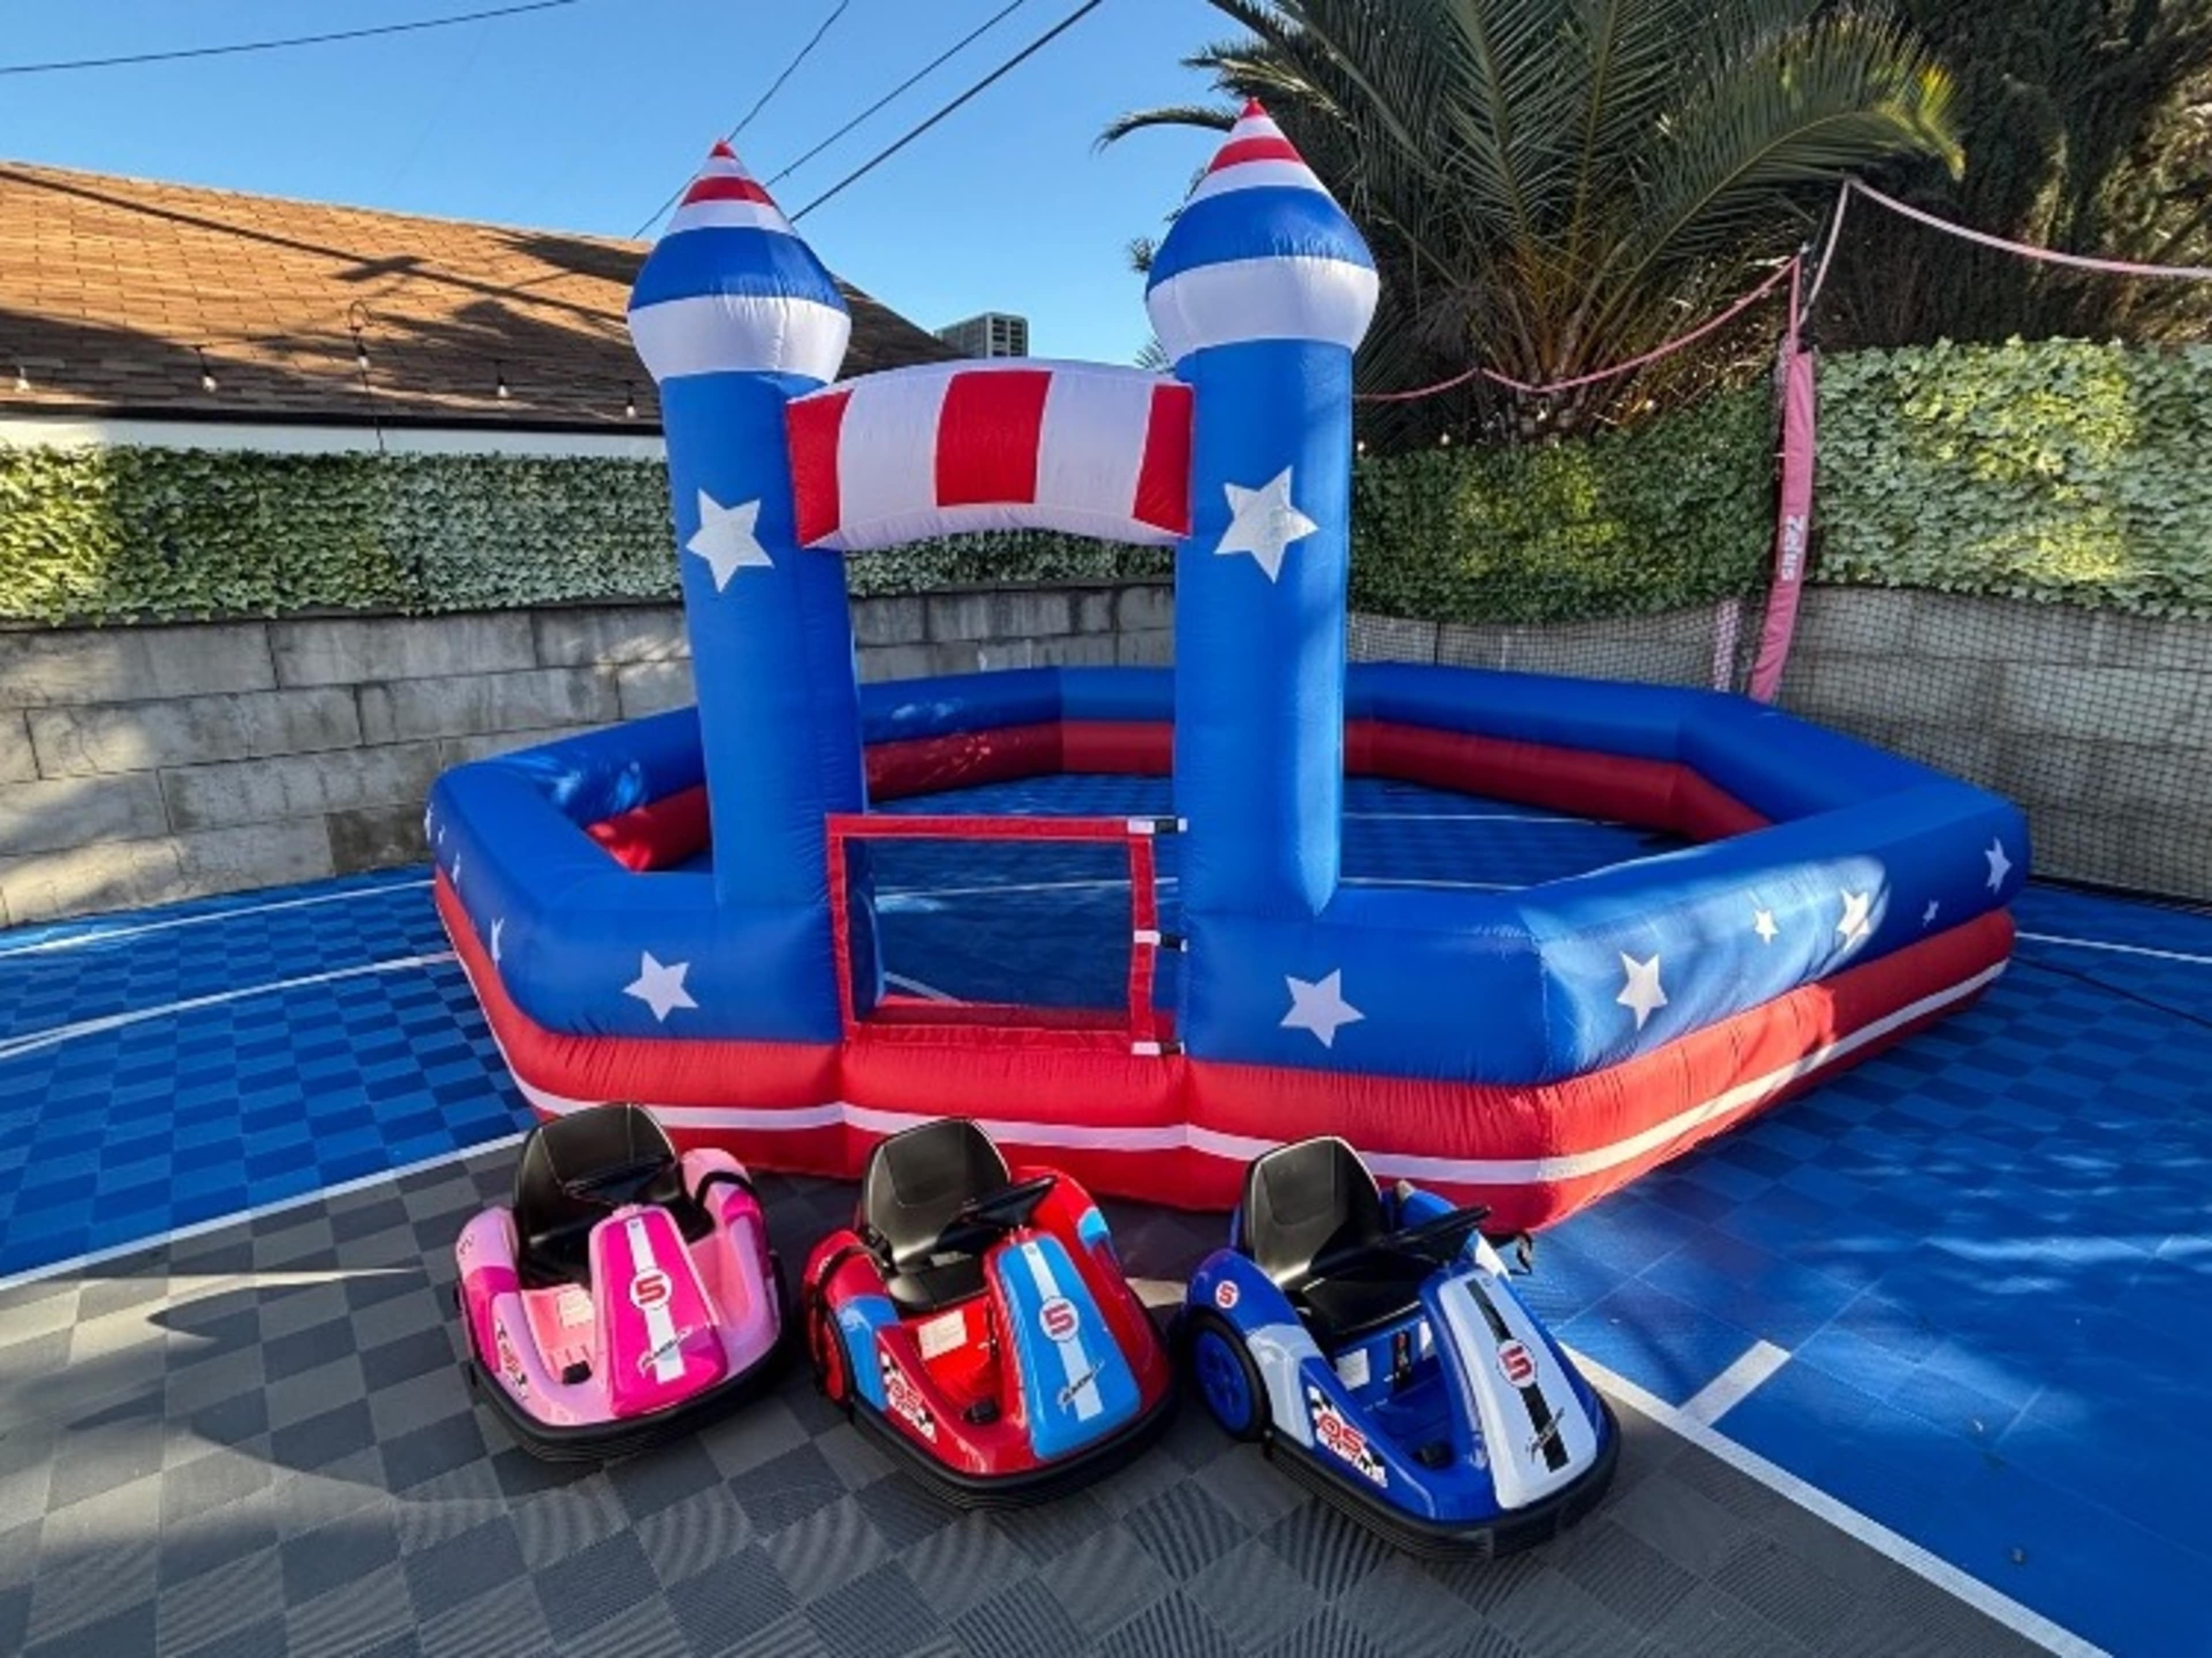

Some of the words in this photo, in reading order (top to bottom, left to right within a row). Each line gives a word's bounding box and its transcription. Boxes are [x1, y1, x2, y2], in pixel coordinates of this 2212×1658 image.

[636, 1274, 666, 1305] 5
[1219, 1284, 1235, 1306] 5
[1043, 1302, 1075, 1336] 5
[1499, 1346, 1532, 1381] 5
